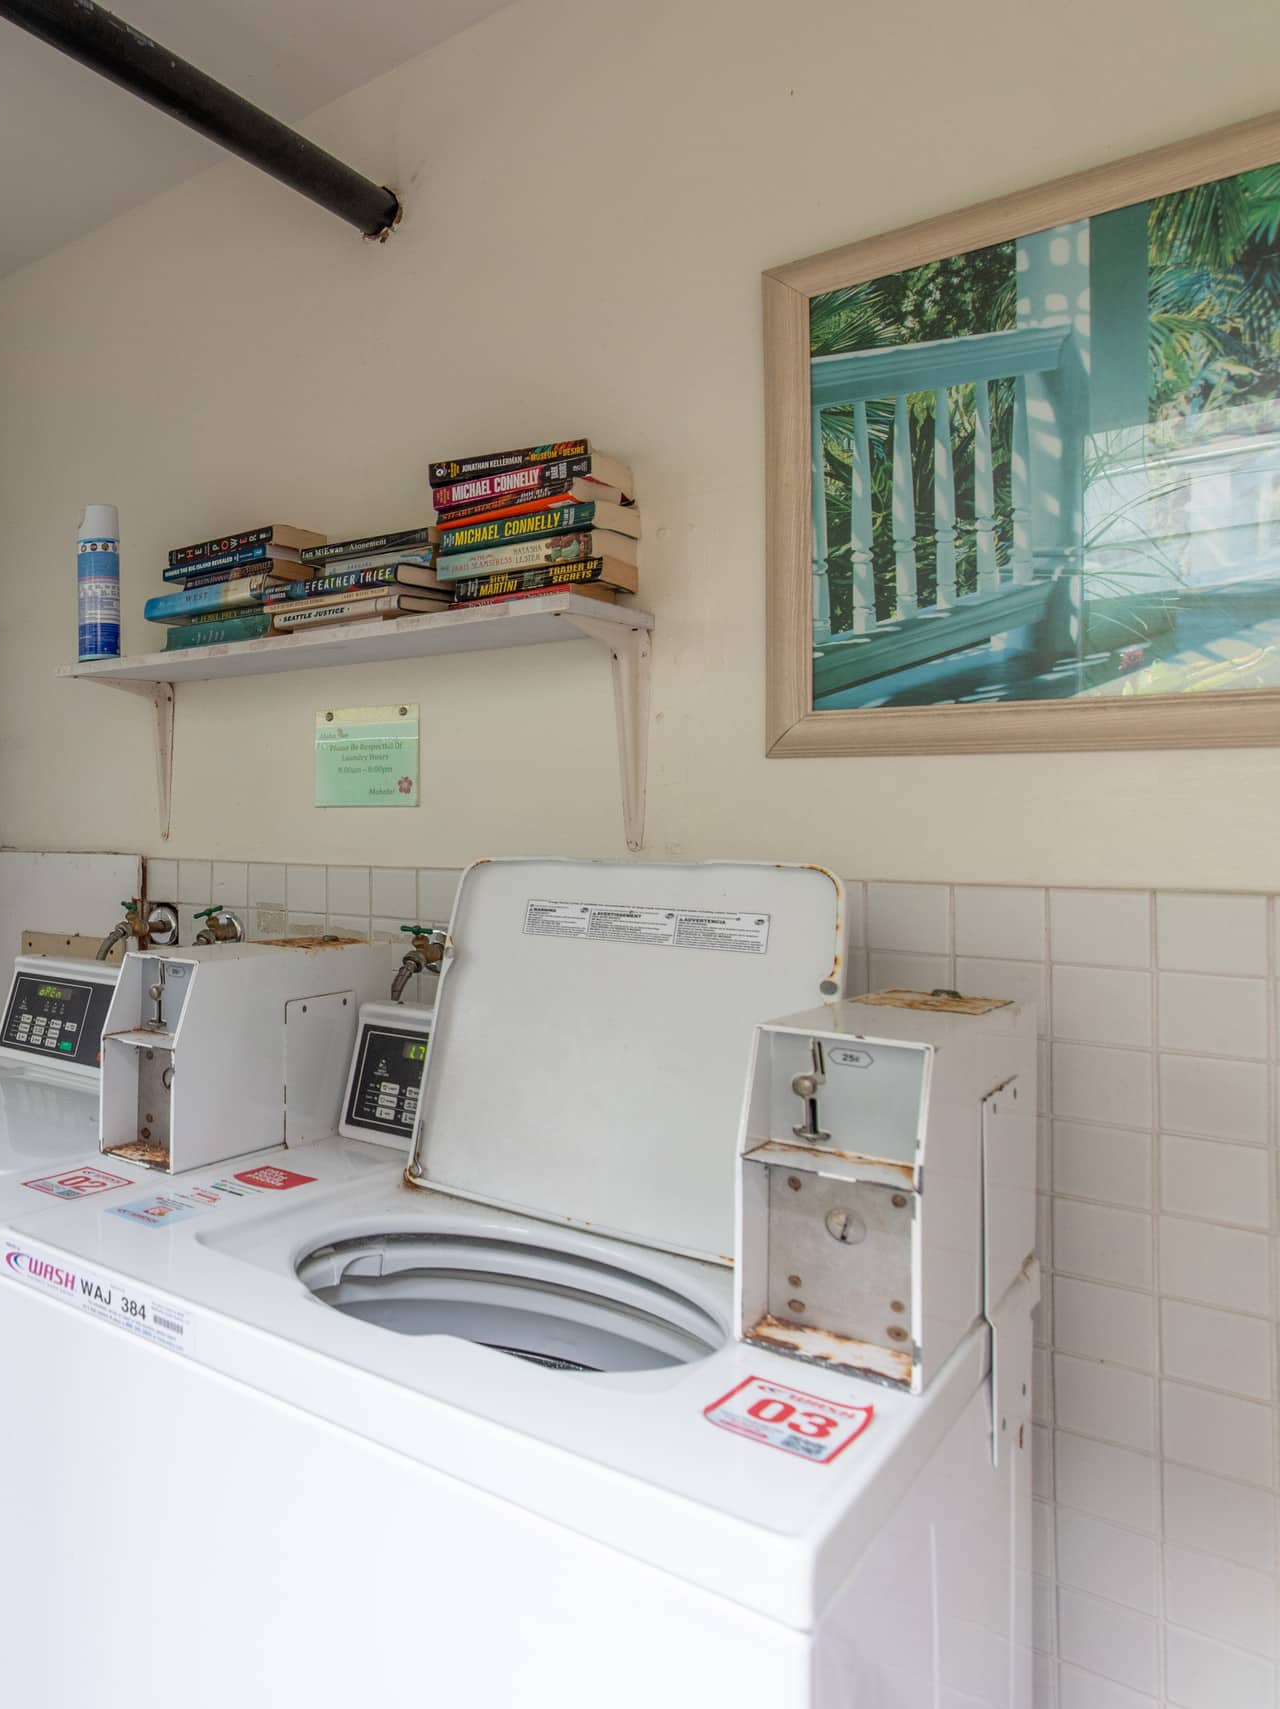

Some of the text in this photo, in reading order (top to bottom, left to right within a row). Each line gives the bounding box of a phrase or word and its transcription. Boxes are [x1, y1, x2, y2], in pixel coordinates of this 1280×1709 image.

[462, 459, 489, 473] JONATHAN
[489, 456, 523, 469] KELLERMAN
[563, 446, 585, 456] DESIRE
[452, 479, 492, 502] MICHAEL
[494, 468, 540, 493] CONNELLY
[455, 523, 499, 546] MICHAEL
[504, 511, 561, 537] CONNELLY
[178, 534, 257, 560] THE POWER
[302, 550, 314, 559] Ian
[349, 538, 387, 551] Atonement
[489, 574, 509, 583] STEVE
[549, 560, 599, 577] TRADER OF
[552, 570, 592, 584] SECRETS
[312, 574, 355, 592] FEATHER
[360, 567, 392, 584] THIEF
[479, 580, 518, 597] MARTINI
[186, 592, 208, 601] WEST
[283, 606, 345, 623] SEATTLE JUSTICE
[57, 1175, 108, 1192] 02
[28, 1257, 76, 1291] WASH
[80, 1278, 112, 1305] WAJ
[121, 1296, 146, 1321] 384
[747, 1398, 838, 1438] 03
